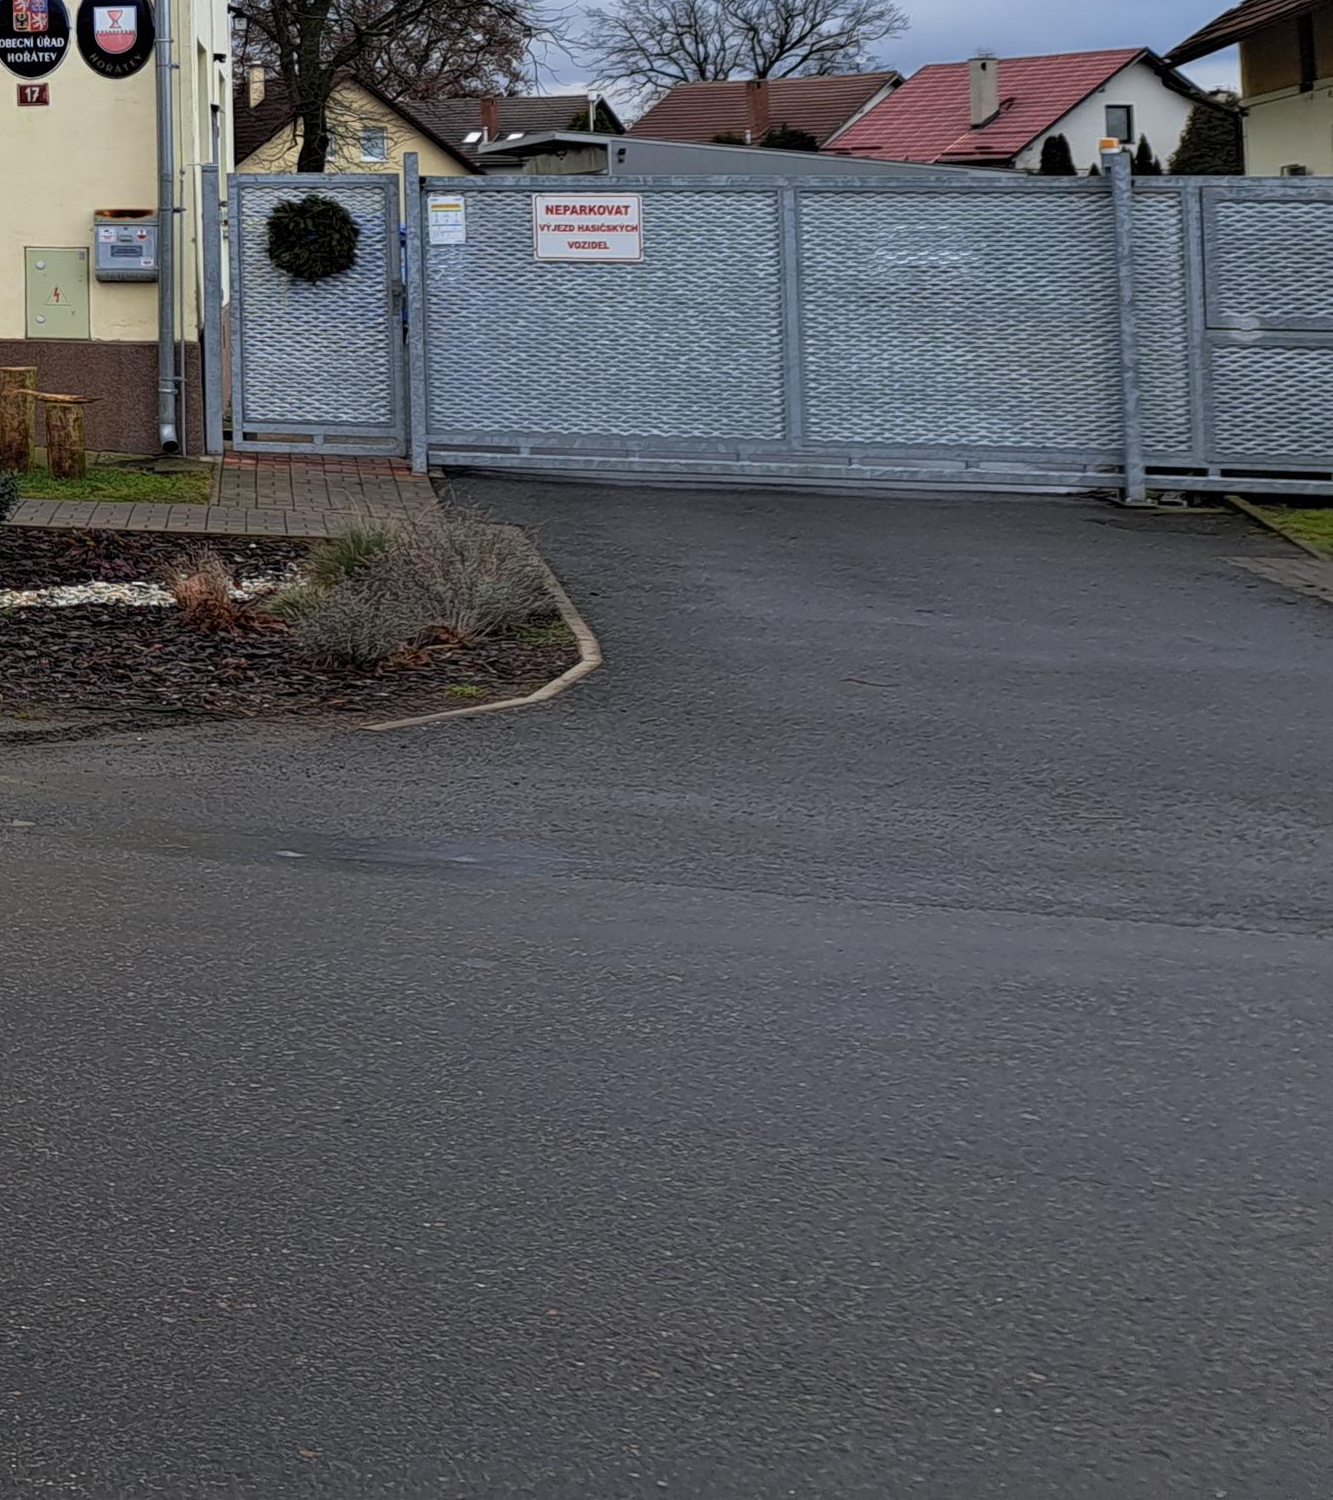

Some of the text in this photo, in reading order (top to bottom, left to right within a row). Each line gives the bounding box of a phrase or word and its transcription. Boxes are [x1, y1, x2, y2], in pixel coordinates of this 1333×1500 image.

[36, 35, 65, 48] ÚŘAD
[7, 50, 58, 63] HOŘÁTEV
[25, 86, 40, 102] 17
[545, 204, 631, 216] NEPARKOVAT
[539, 221, 639, 233] VÝJEZD HASIČSKÝCH
[567, 240, 610, 250] VOZIDEL
